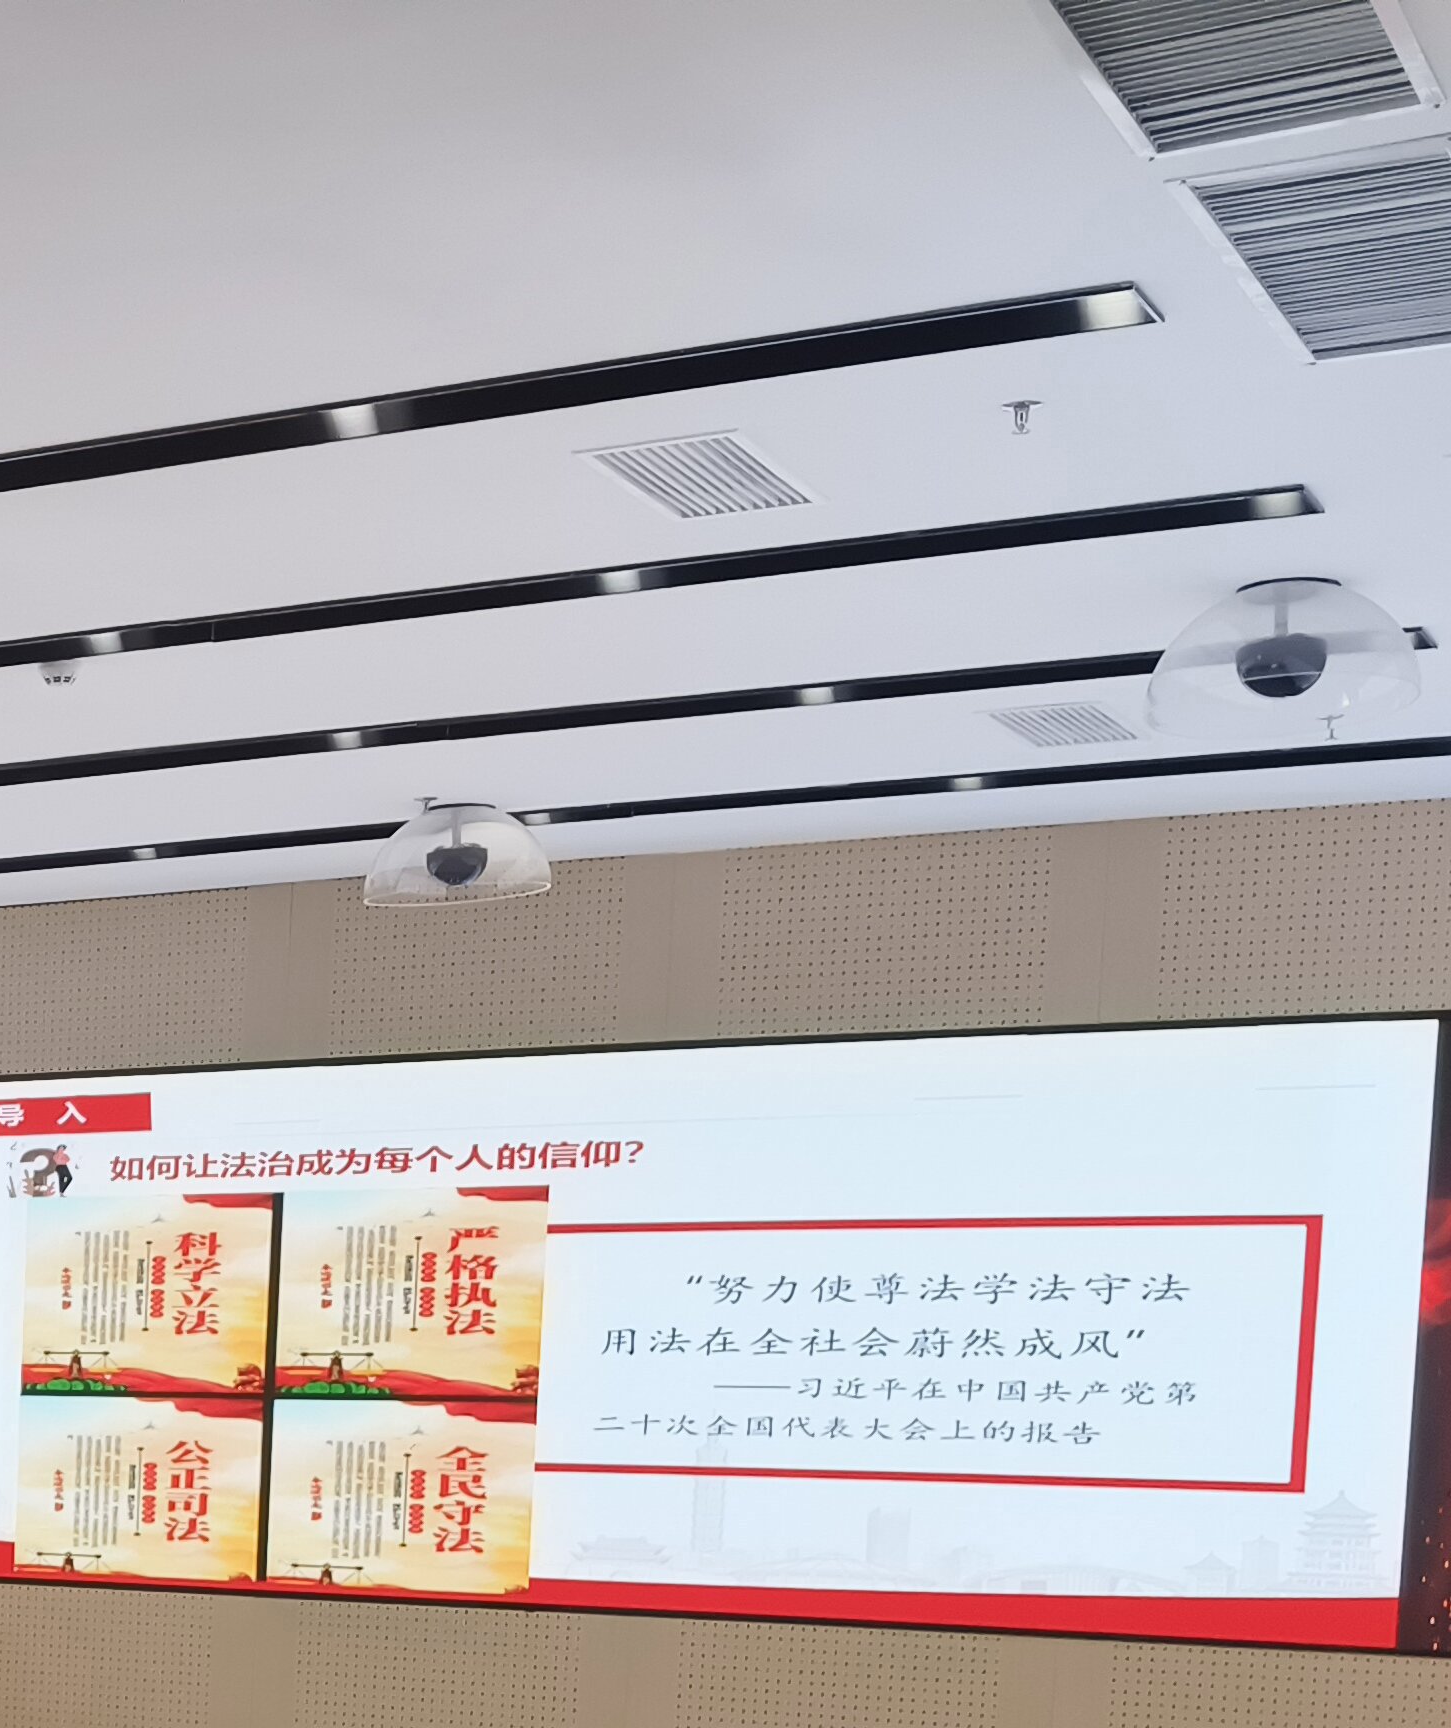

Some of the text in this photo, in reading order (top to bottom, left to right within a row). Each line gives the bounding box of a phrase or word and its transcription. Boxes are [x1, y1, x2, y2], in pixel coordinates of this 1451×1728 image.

[109, 1140, 645, 1182] 如何让法治成为每个人的信仰?
[173, 1231, 221, 1336] 科学立法
[444, 1226, 499, 1336] 严格执法
[686, 1273, 1190, 1306] “努力使尊法学法守法
[601, 1326, 1146, 1360] 用法在全社会蔚然成风”
[593, 1413, 1101, 1445] 二十次全国代表大会上的报告
[165, 1440, 214, 1543] 公正司法
[433, 1446, 489, 1553] 全民守法
